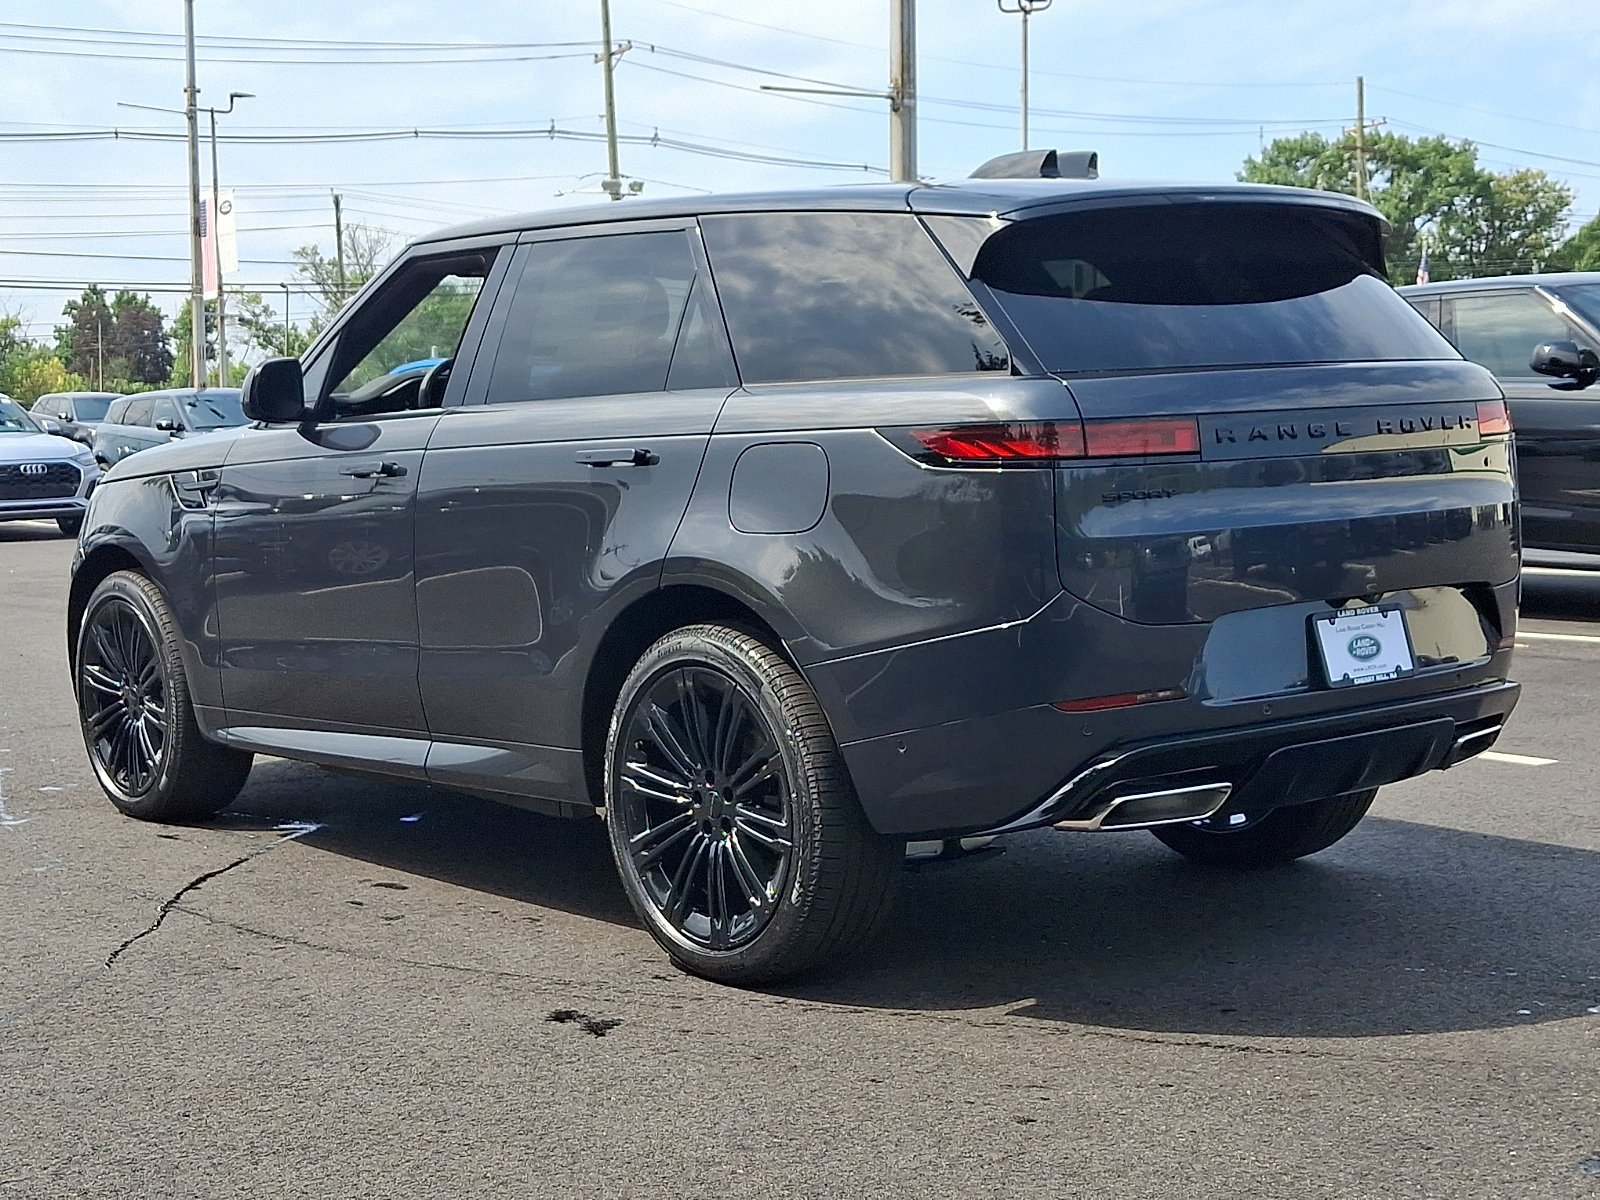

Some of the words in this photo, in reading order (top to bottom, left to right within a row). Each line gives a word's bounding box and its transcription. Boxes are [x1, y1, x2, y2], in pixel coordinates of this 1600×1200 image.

[1214, 421, 1353, 444] RANGE
[1376, 414, 1473, 435] ROVER
[1101, 488, 1177, 503] SPORT
[1337, 609, 1355, 618] LAND
[1356, 606, 1378, 615] ROVER
[1353, 638, 1370, 648] LAND
[1356, 645, 1377, 656] ROVER
[1354, 675, 1375, 685] CHERRY
